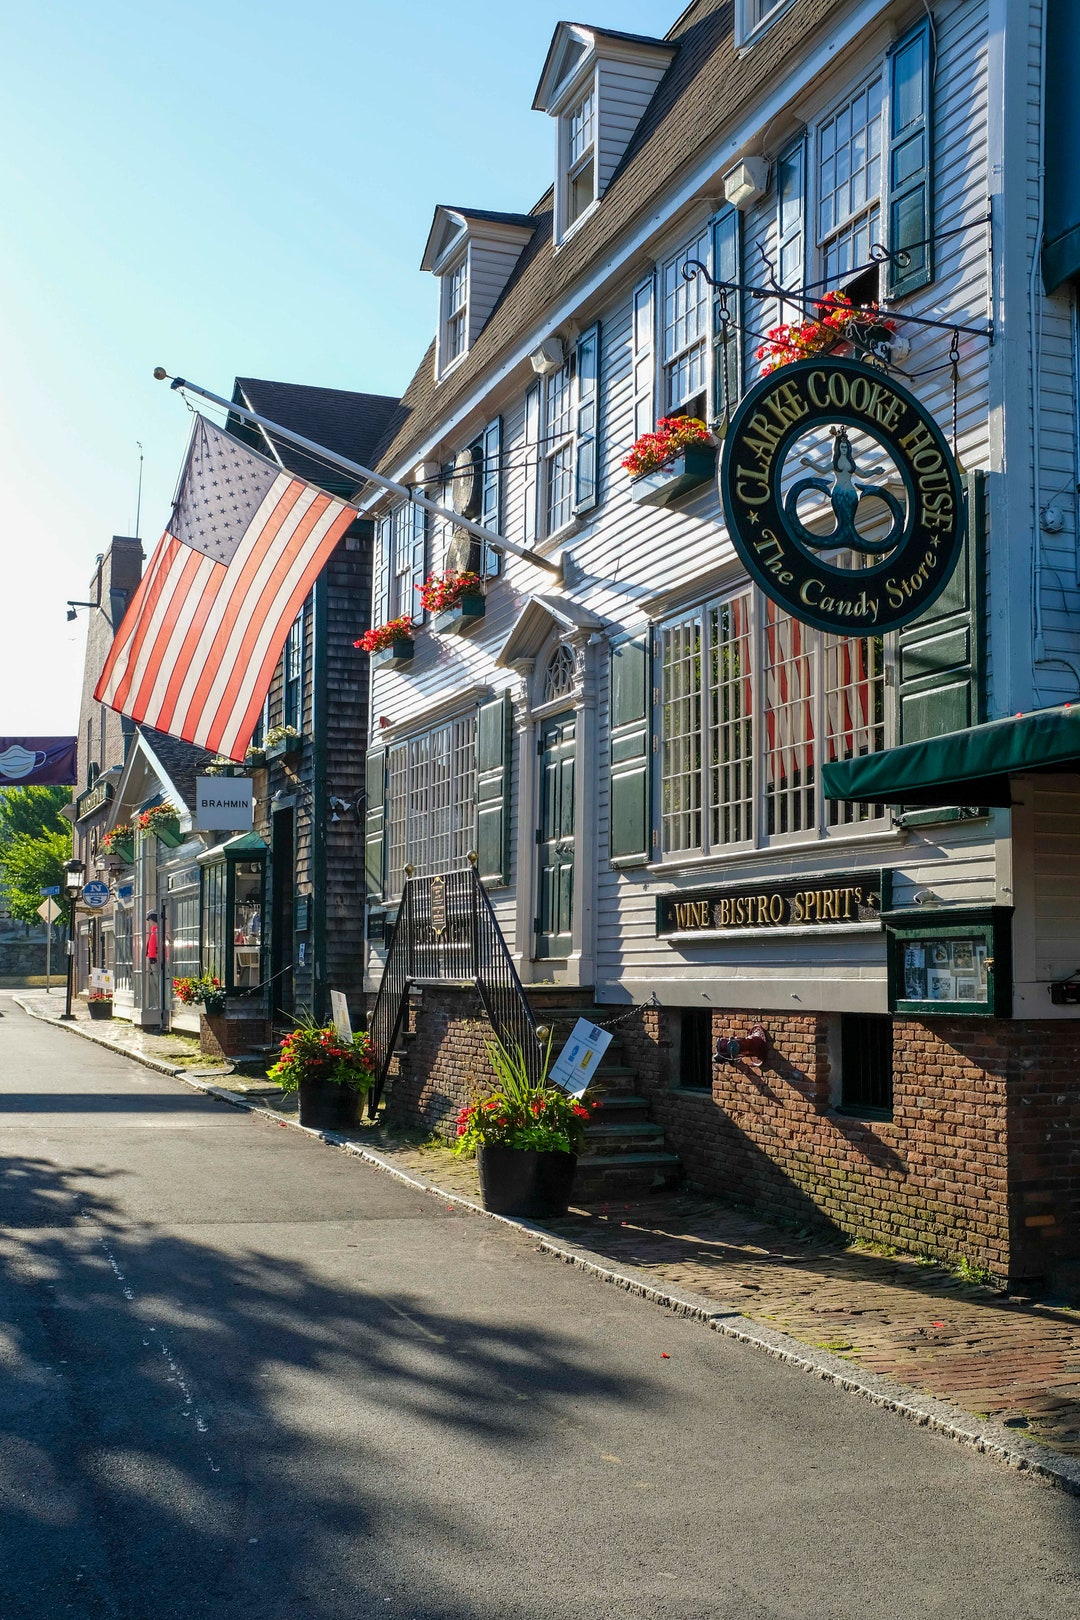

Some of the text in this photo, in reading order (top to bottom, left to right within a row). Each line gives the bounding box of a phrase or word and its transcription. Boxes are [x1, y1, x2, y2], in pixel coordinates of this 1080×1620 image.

[736, 371, 954, 533] CLARKE COOKE HOUSE
[752, 528, 937, 623] The Candy Store
[201, 799, 249, 808] BRAHMIN
[90, 884, 102, 892] N
[90, 896, 102, 905] S
[674, 900, 710, 928] WINE
[719, 894, 784, 925] BISTRO
